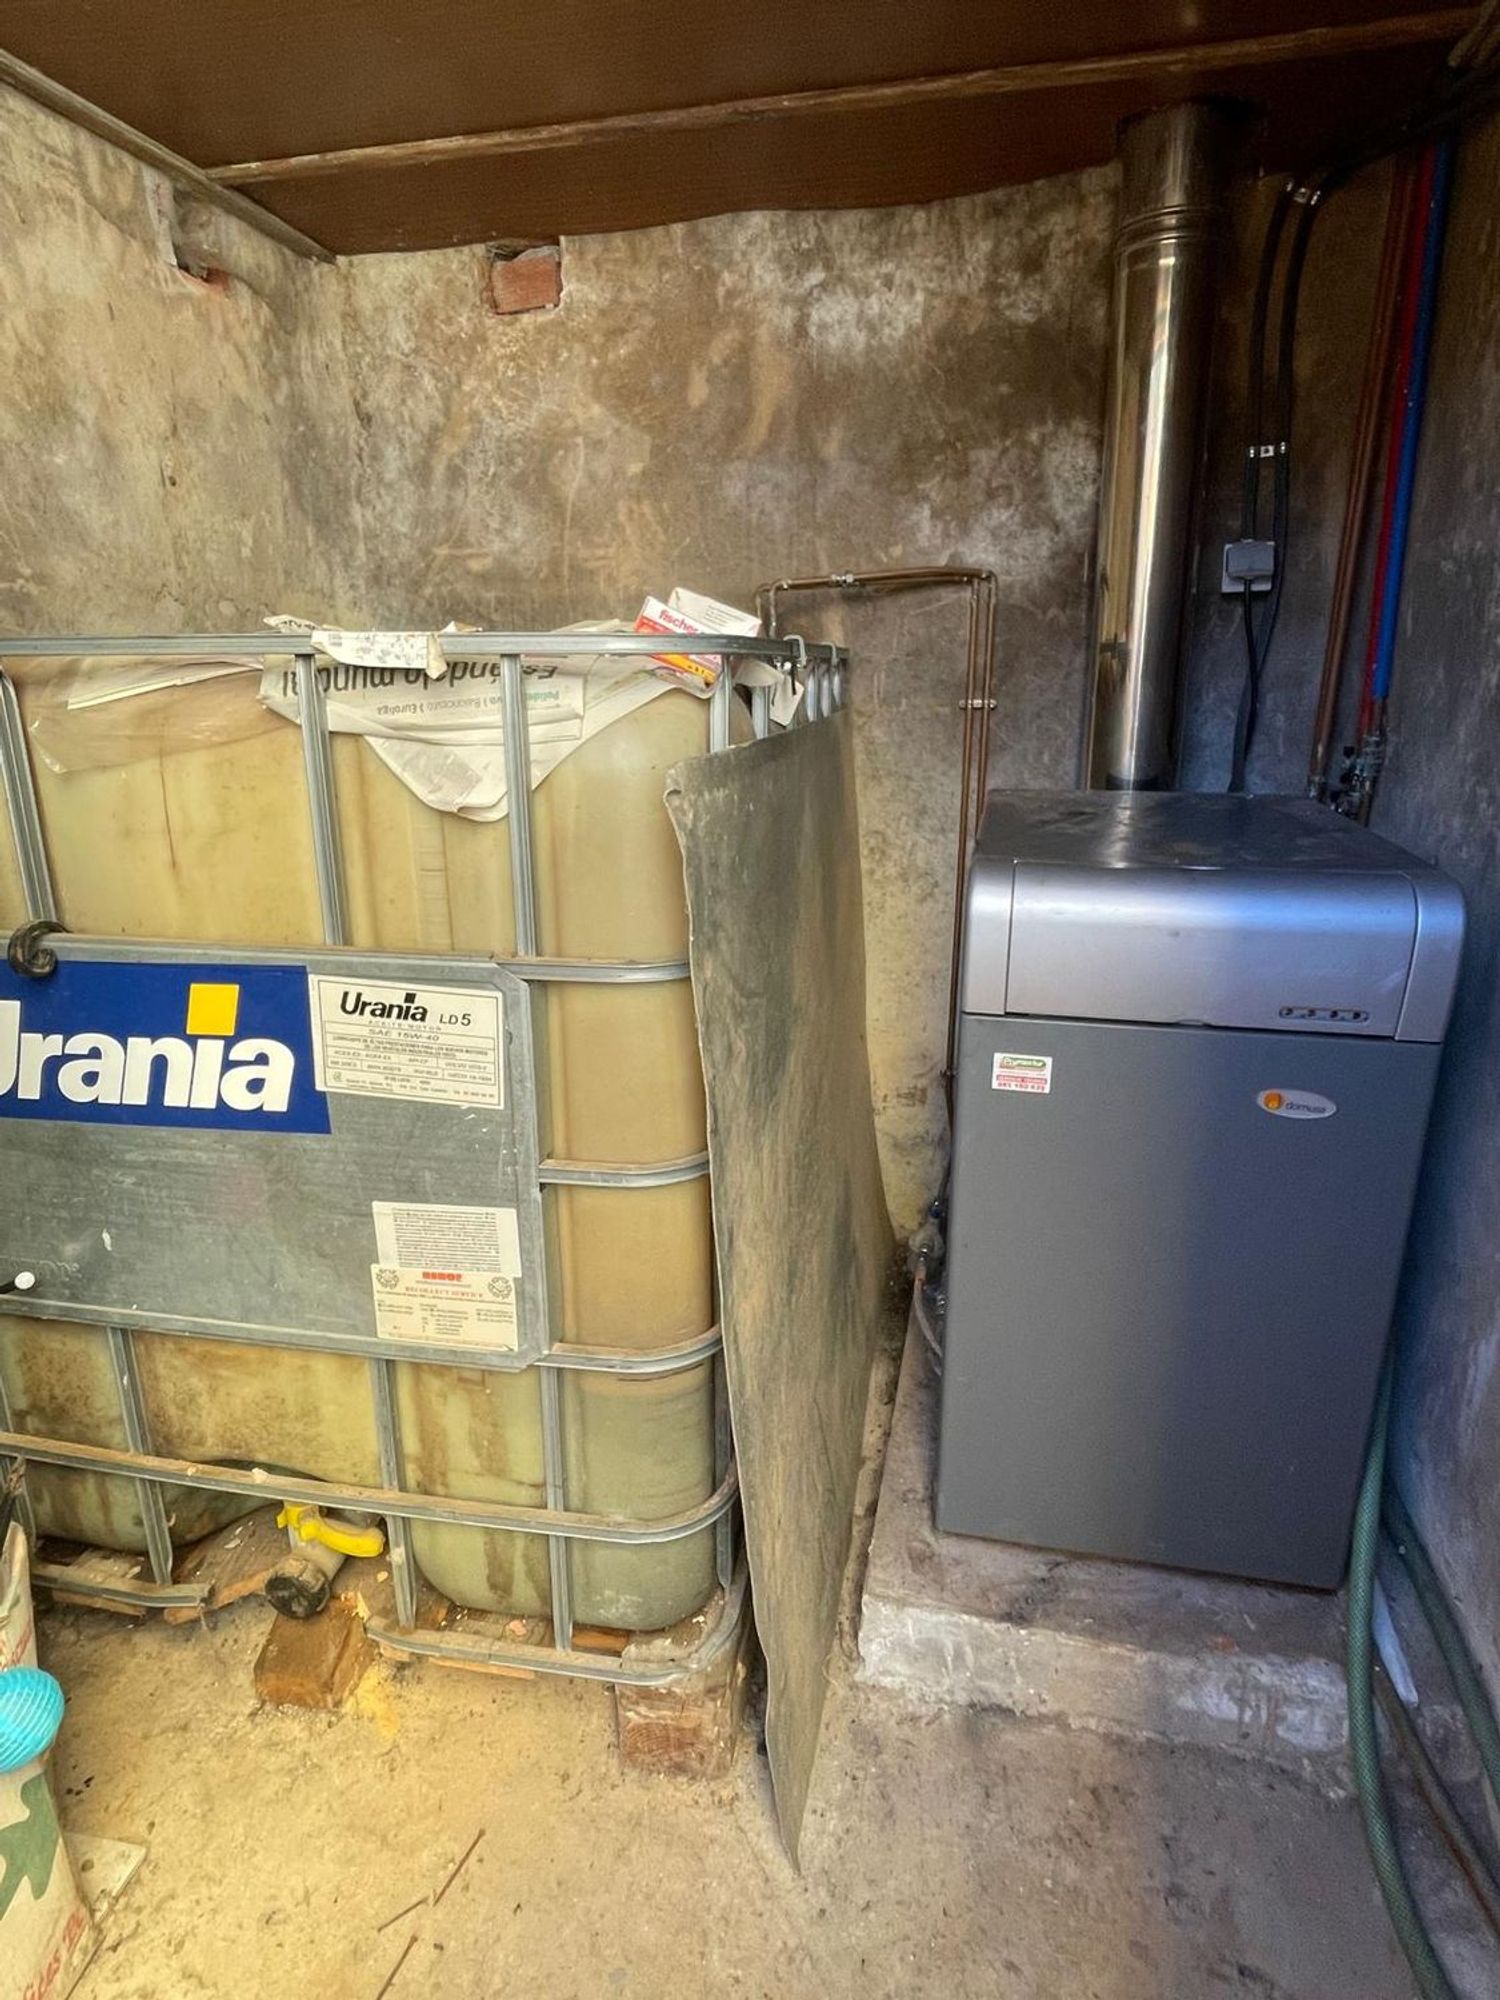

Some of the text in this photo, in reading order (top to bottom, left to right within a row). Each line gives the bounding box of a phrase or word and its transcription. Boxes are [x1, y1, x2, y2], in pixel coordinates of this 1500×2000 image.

[377, 702, 418, 715] Euroliga
[340, 991, 428, 1022] Urania
[0, 983, 295, 1113] rania
[1285, 1102, 1327, 1114] domusa
